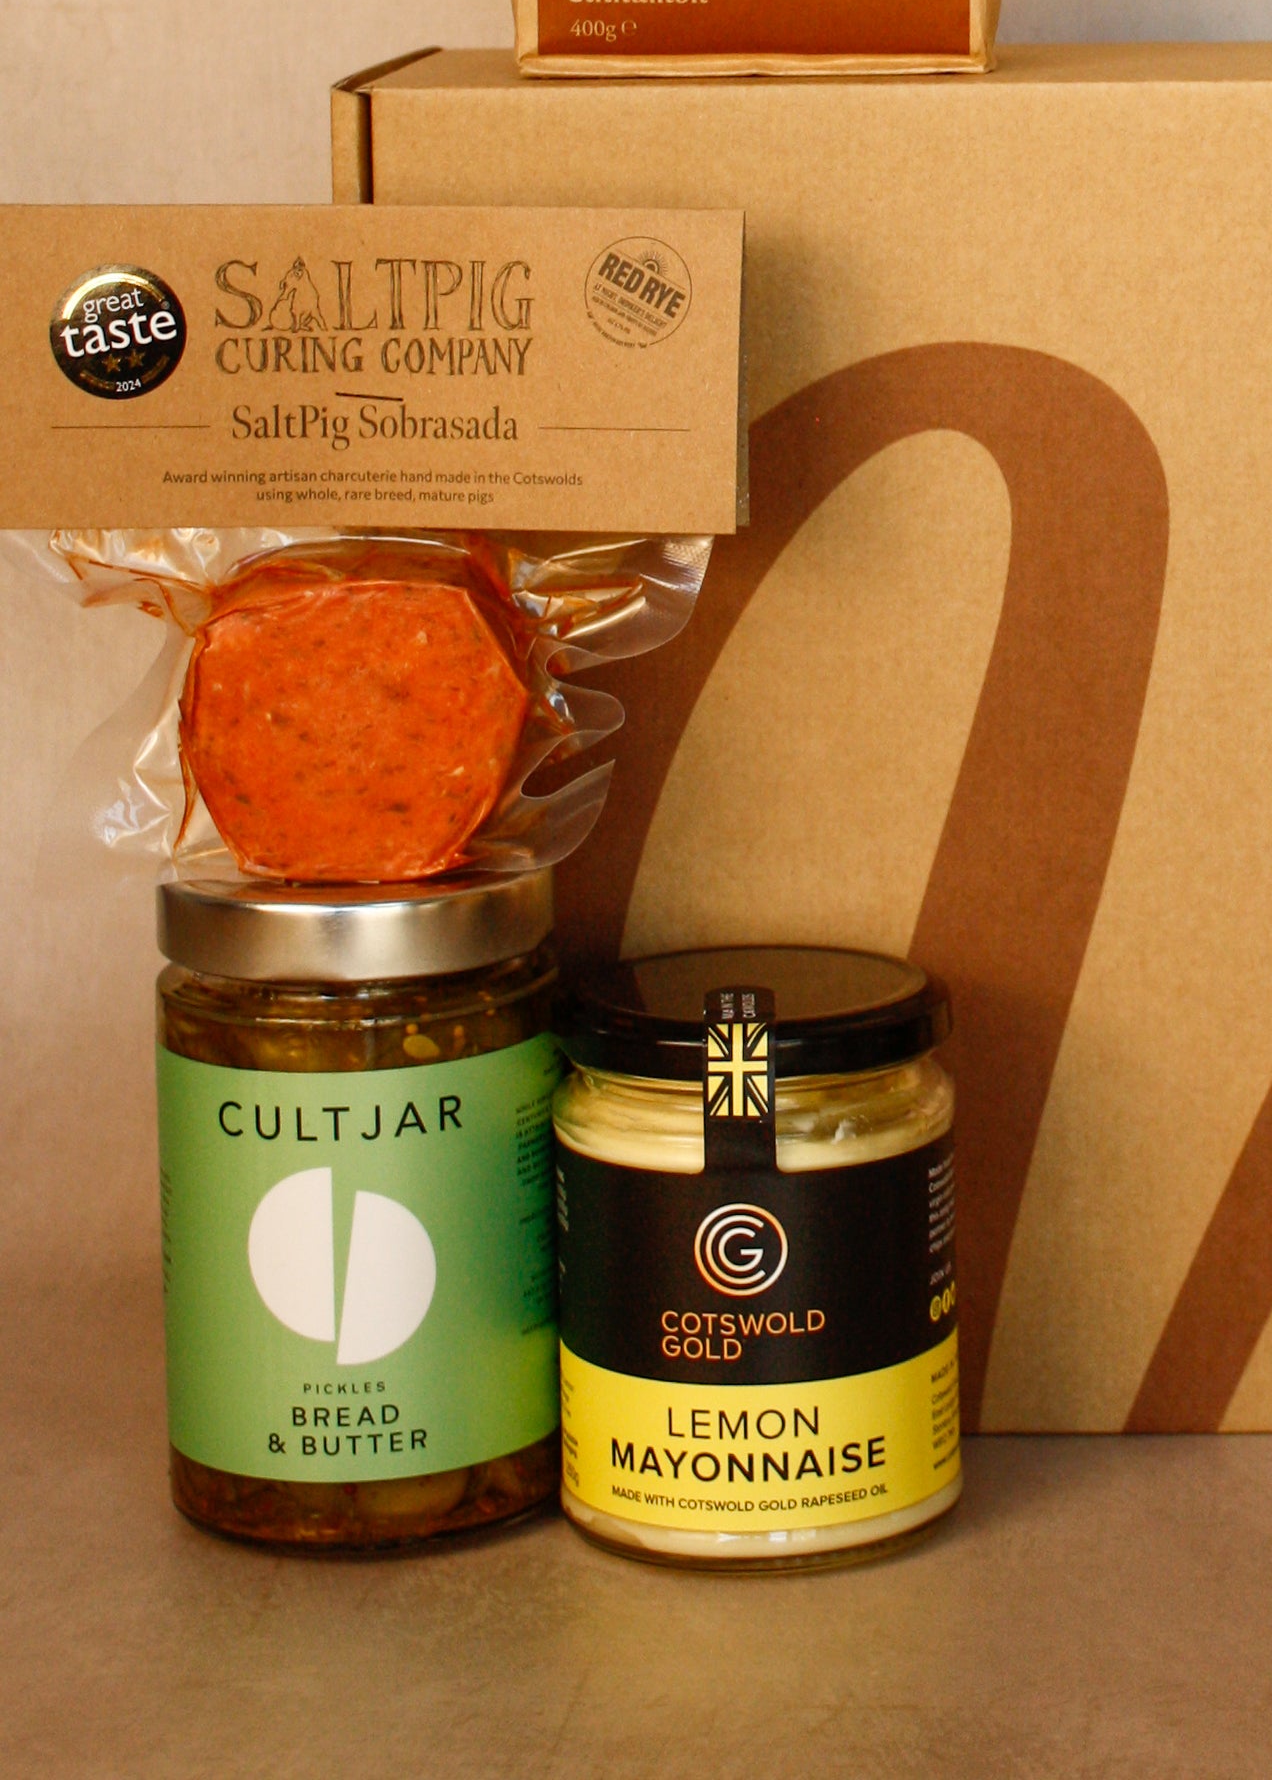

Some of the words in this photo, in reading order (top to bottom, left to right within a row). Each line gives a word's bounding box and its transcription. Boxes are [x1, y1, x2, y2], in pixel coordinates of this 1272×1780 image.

[570, 19, 617, 42] 400g
[598, 252, 645, 293] RED
[639, 276, 686, 318] RYE
[83, 288, 144, 324] great
[60, 310, 177, 358] taste
[214, 336, 365, 374] CURING
[380, 337, 533, 376] COMPANY
[116, 378, 141, 392] 2024
[231, 404, 350, 450] SaltPig
[358, 403, 518, 440] Sobrasada
[163, 471, 208, 484] Award
[211, 471, 266, 486] winning
[269, 471, 317, 482] artisan
[320, 470, 397, 483] charcuterie
[401, 470, 432, 483] hand
[435, 471, 471, 484] made
[474, 472, 486, 484] in
[487, 472, 511, 484] the
[513, 472, 583, 486] Cotswolds
[256, 489, 293, 504] using
[296, 487, 342, 501] whole,
[344, 491, 372, 501] rare
[375, 489, 415, 503] breed,
[419, 491, 465, 503] mature
[468, 491, 494, 506] pigs
[218, 1095, 463, 1141] CULTJAR
[661, 1309, 826, 1336] COTSWOLD
[661, 1335, 743, 1360] GOLD
[303, 1381, 386, 1395] PICKLES
[292, 1404, 400, 1427] BREAD
[667, 1406, 820, 1440] LEMON
[268, 1433, 286, 1454] &
[302, 1429, 428, 1456] BUTTER
[611, 1435, 886, 1482] MAYONNAISE
[612, 1485, 642, 1502] MADE
[644, 1493, 675, 1509] WITH
[678, 1498, 755, 1512] COTSWOLD
[759, 1499, 797, 1511] GOLD
[801, 1488, 868, 1508] RAPESEED
[870, 1483, 888, 1496] OIL
